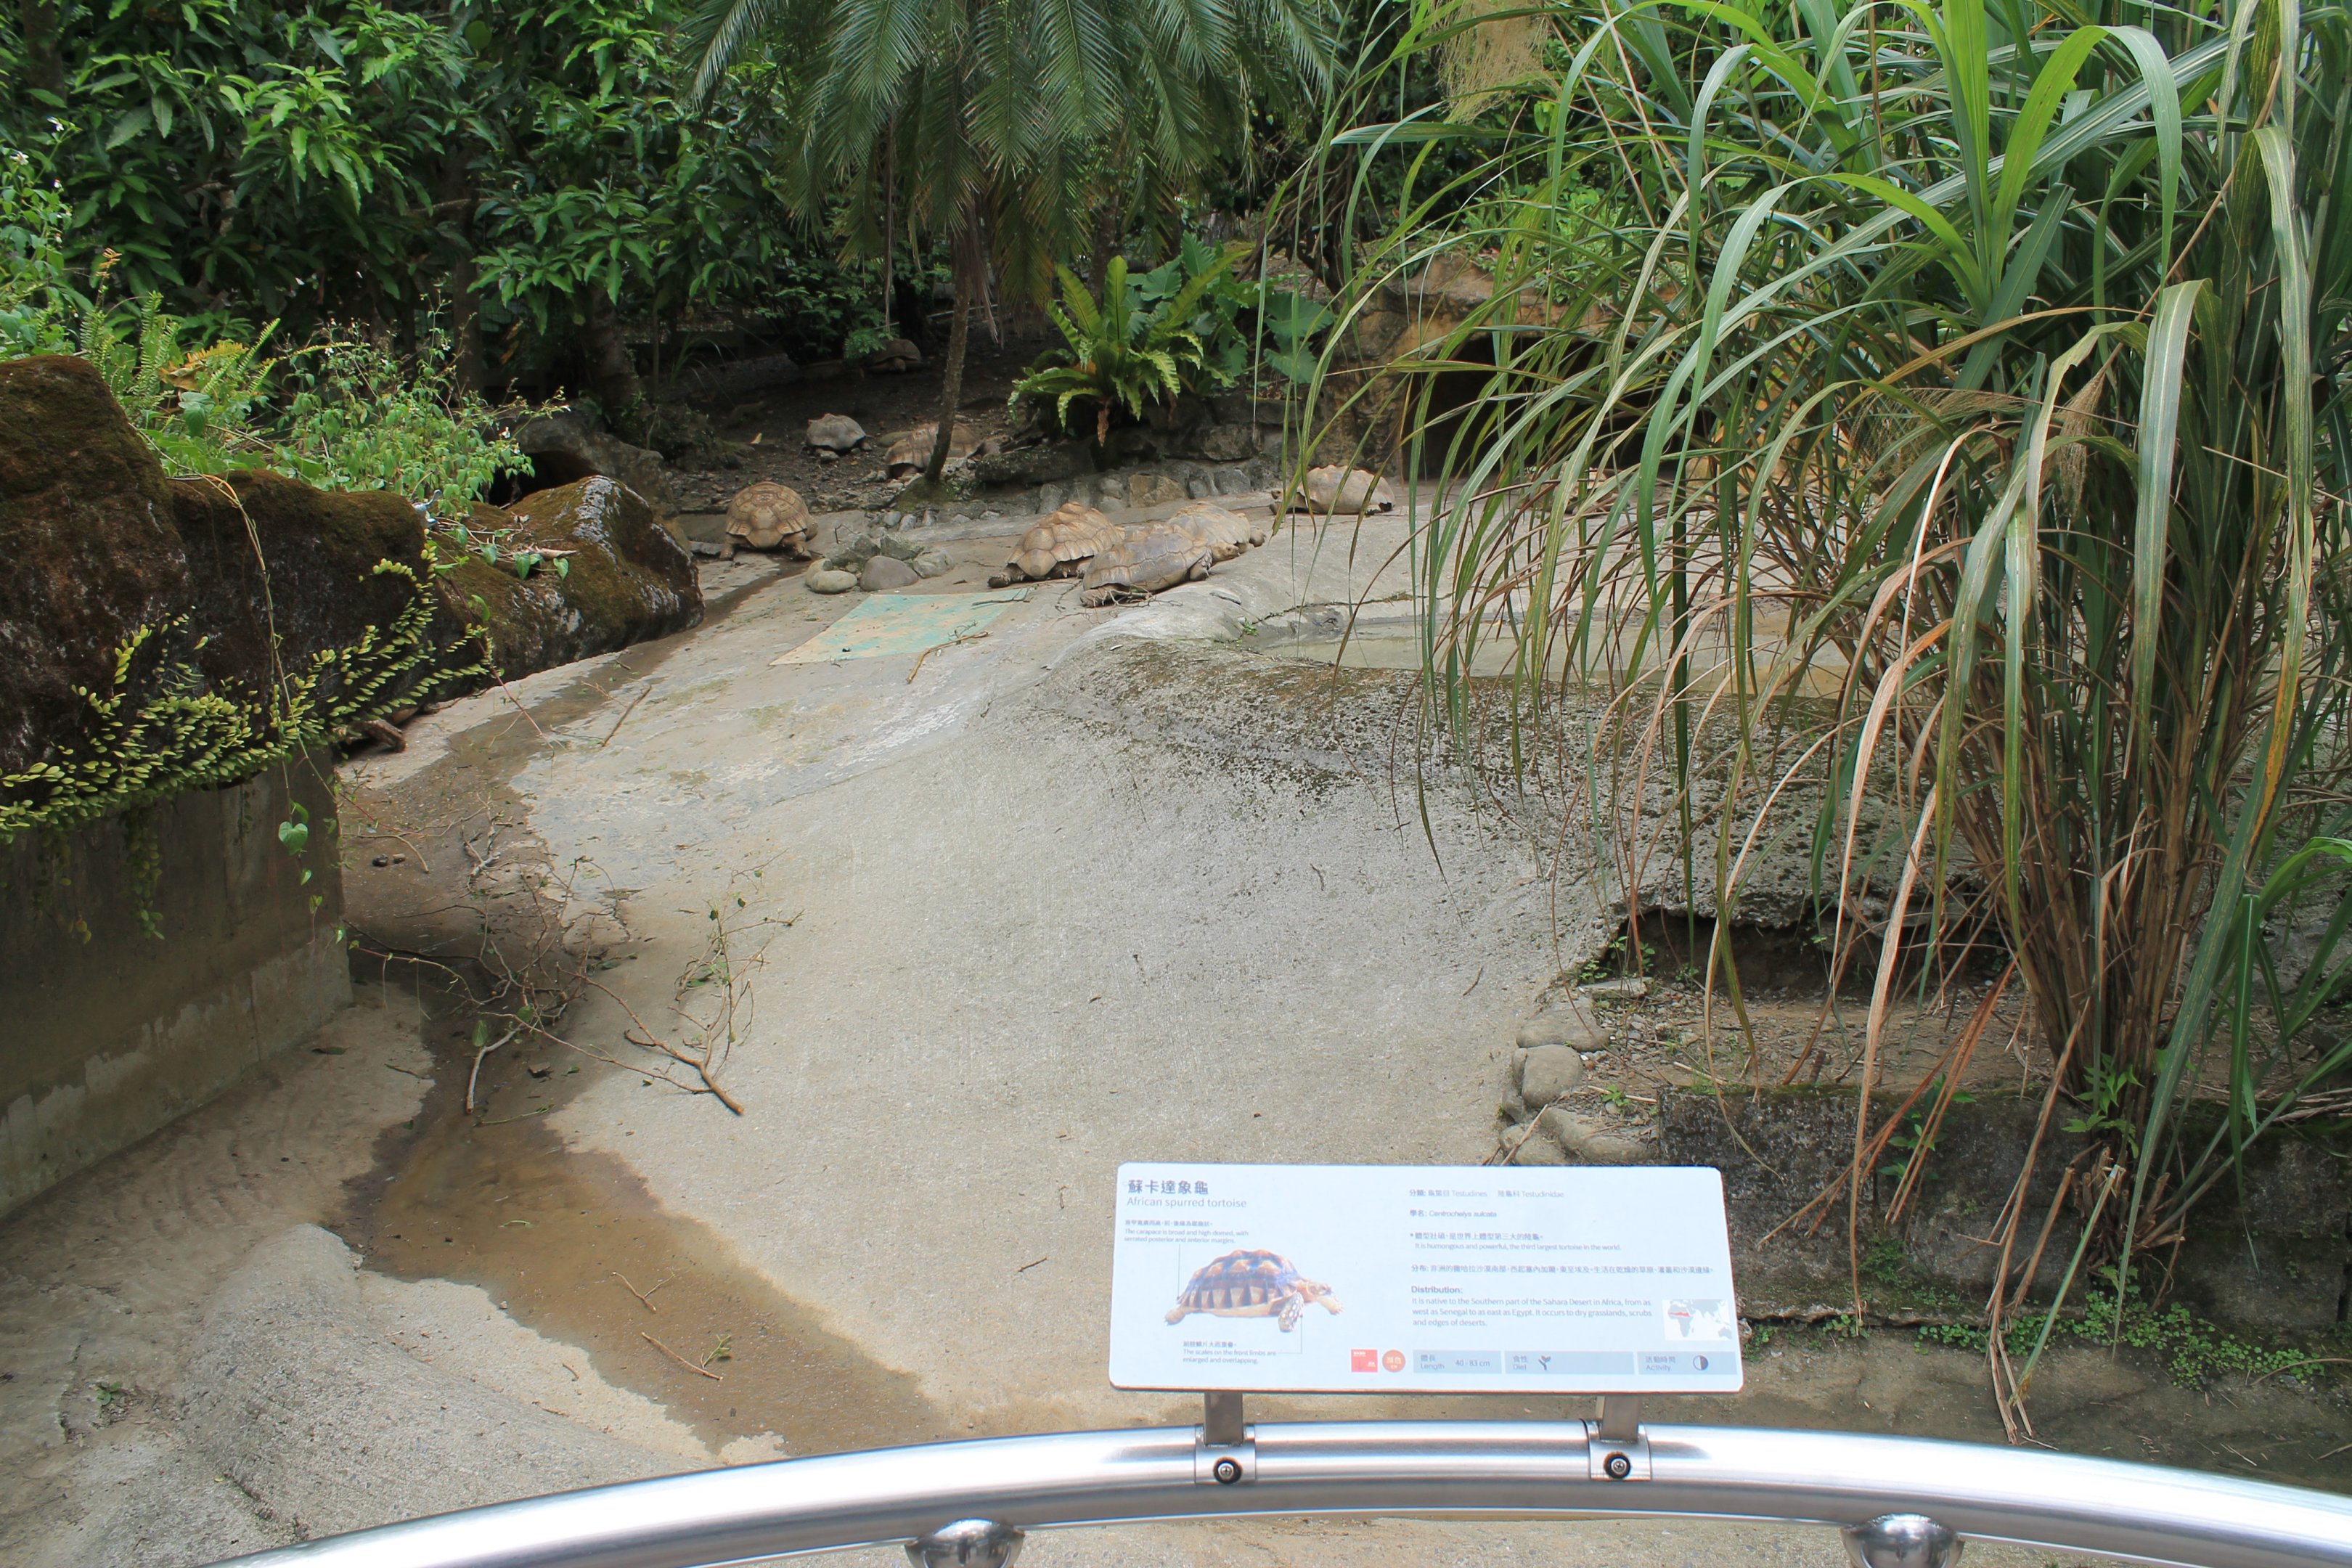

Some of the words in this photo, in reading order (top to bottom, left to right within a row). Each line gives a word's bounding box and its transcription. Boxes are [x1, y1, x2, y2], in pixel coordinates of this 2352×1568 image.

[1127, 1179, 1209, 1195] 蘇卡達象龜
[1127, 1196, 1162, 1206] African
[1164, 1197, 1205, 1208] spurred
[1207, 1199, 1247, 1208] tortoise
[1440, 1308, 1468, 1317] Senegal
[1428, 1318, 1450, 1327] edges
